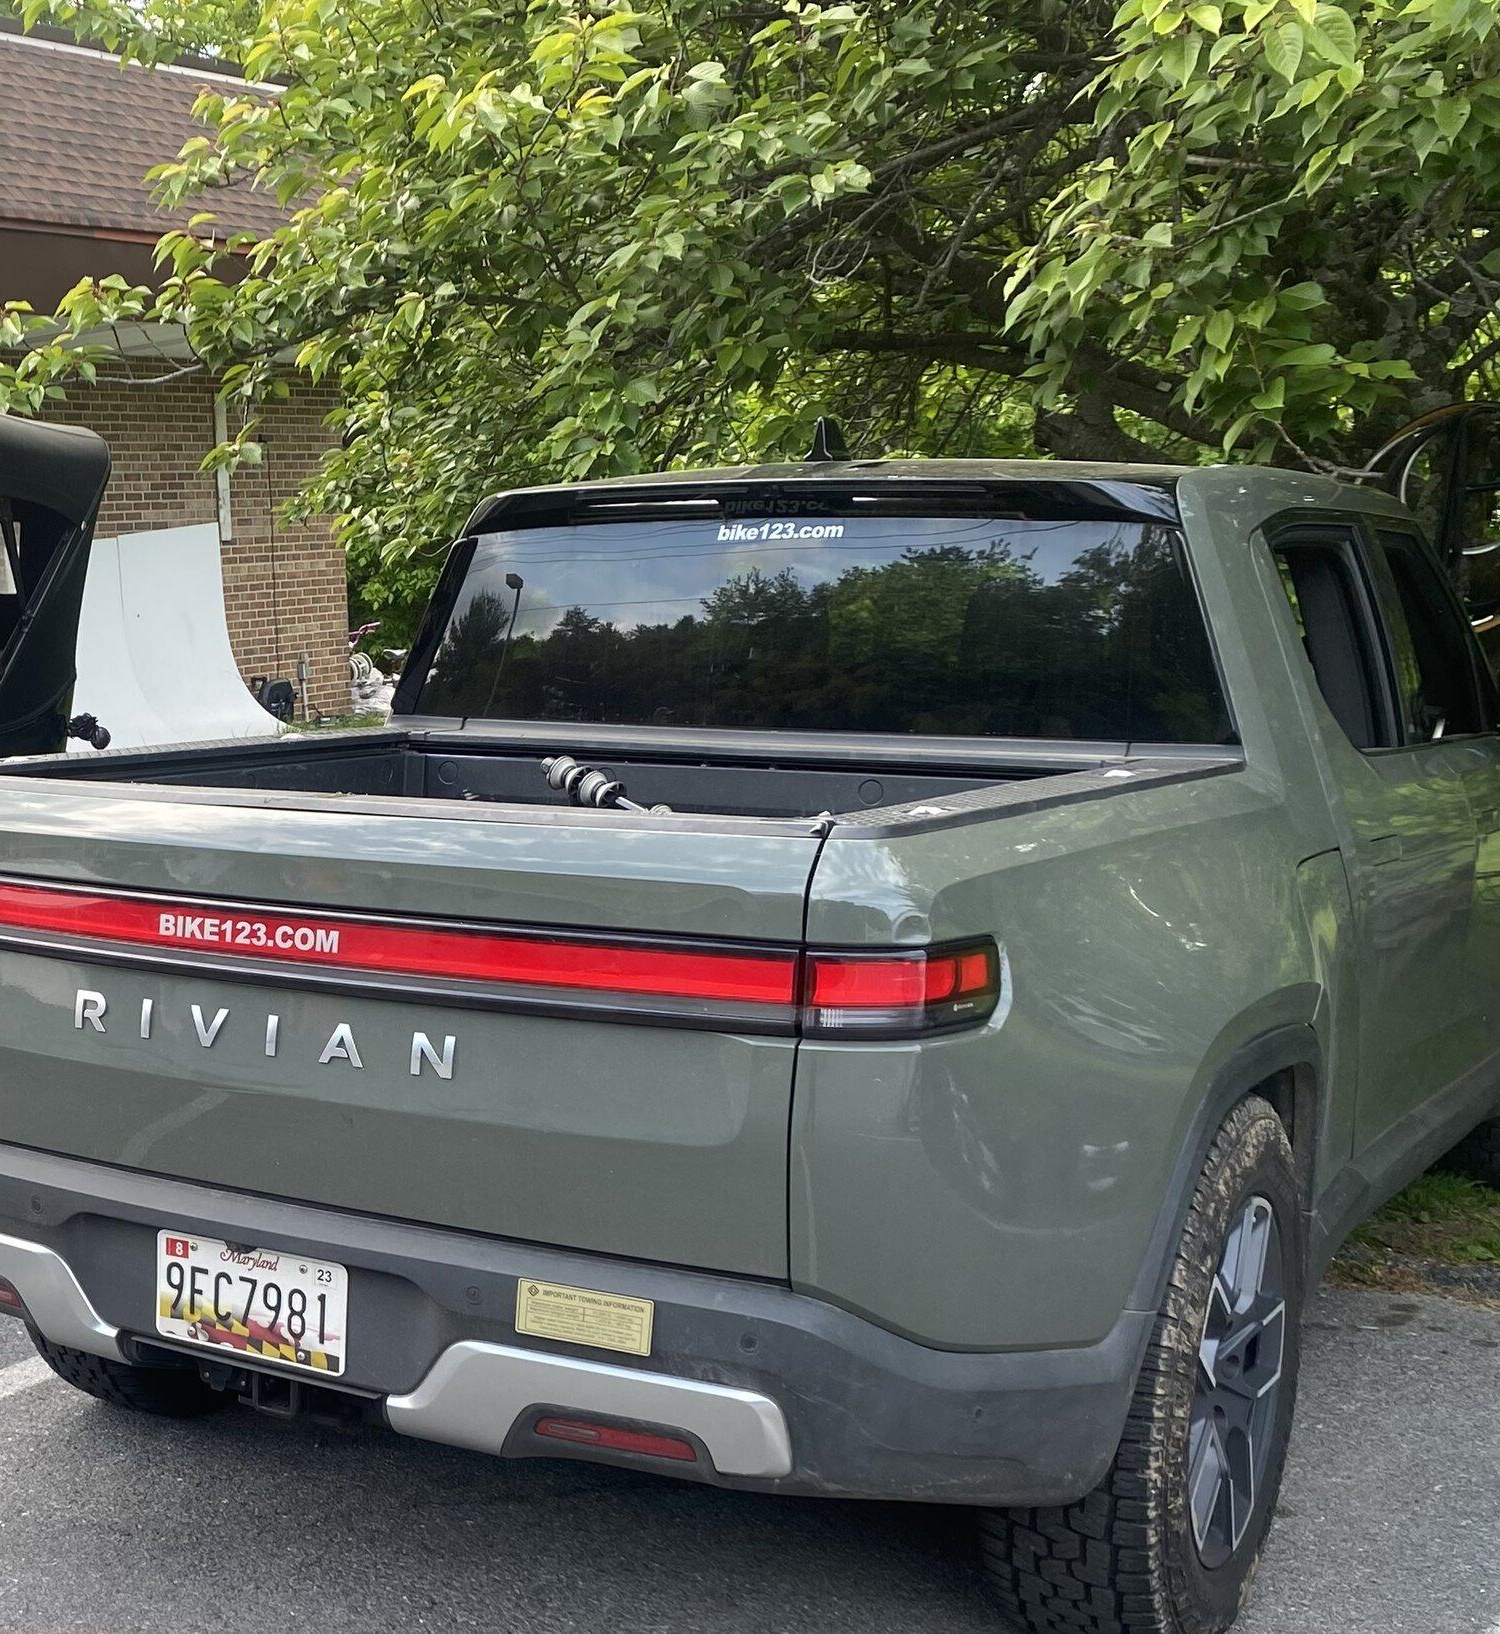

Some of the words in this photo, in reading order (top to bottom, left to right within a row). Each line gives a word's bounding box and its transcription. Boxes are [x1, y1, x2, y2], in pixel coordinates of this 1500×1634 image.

[716, 522, 845, 542] bike123.com
[158, 913, 340, 954] BIKE123.COM
[73, 988, 457, 1080] RIVIAN
[175, 1241, 183, 1256] 8
[220, 1248, 279, 1272] Maryland
[317, 1269, 332, 1283] 23
[166, 1261, 327, 1345] 9FC7981
[542, 1289, 577, 1301] IMPORTANT
[578, 1295, 602, 1306] TOWING
[603, 1299, 645, 1313] INFORMATION
